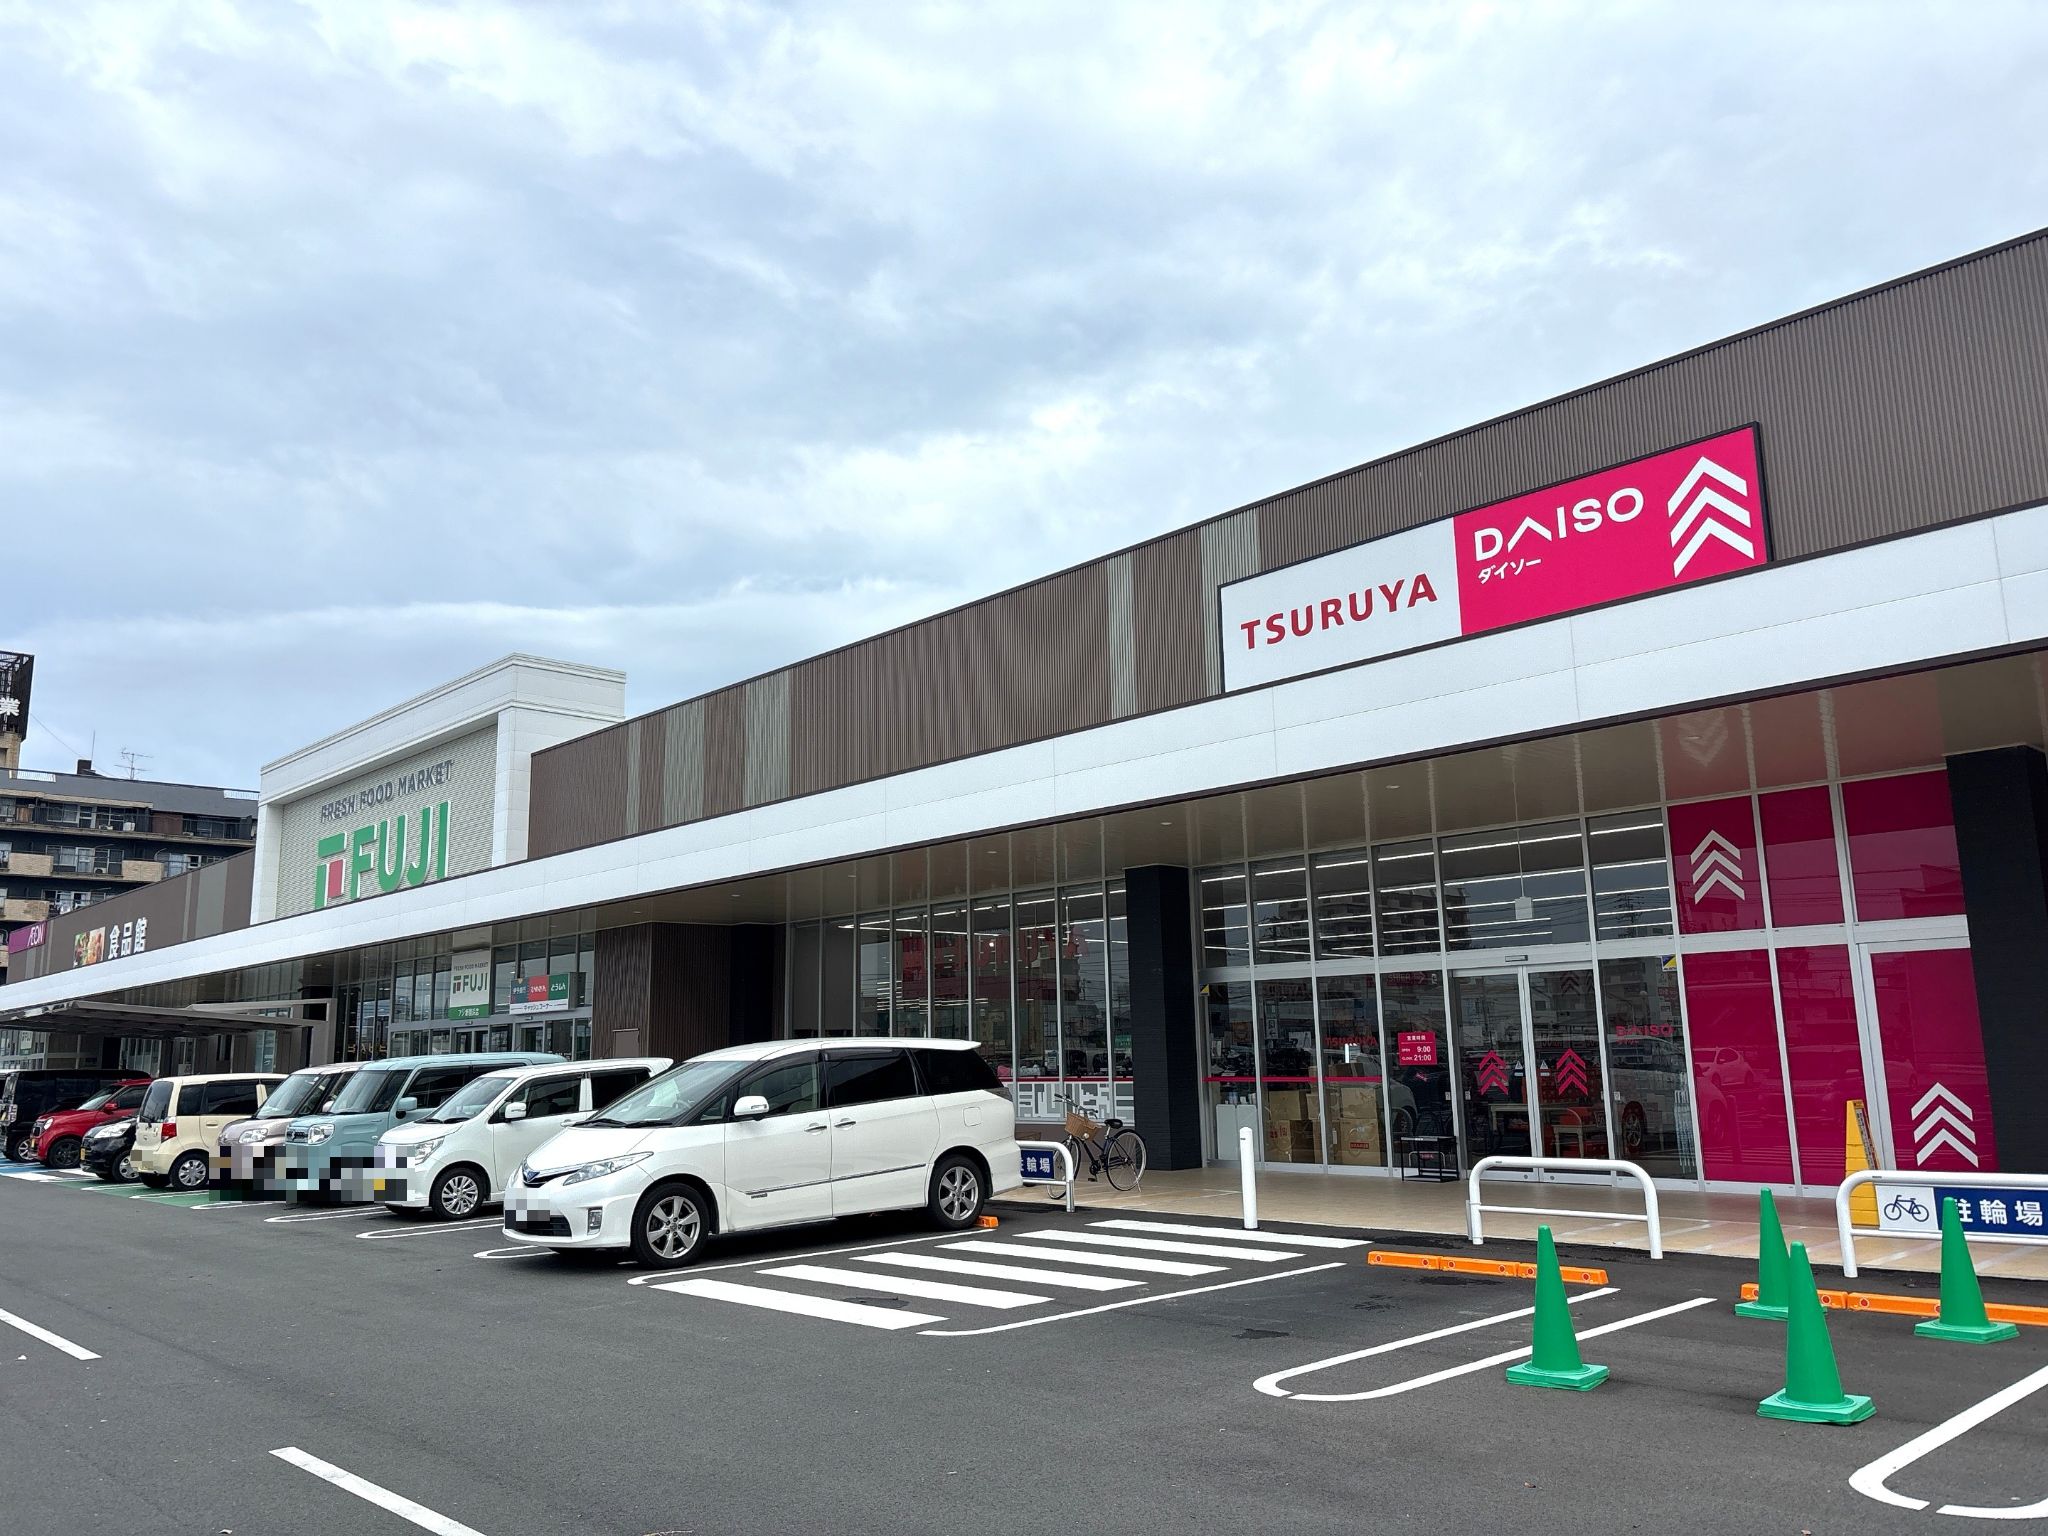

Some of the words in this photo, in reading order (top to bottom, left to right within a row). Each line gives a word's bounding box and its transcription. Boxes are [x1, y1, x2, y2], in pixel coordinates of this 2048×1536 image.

[1475, 487, 1644, 561] DAISO
[1478, 557, 1541, 584] ダイソー
[1240, 573, 1438, 650] TSURUYA
[320, 794, 356, 823] FRESH
[359, 782, 394, 809] FOOD
[398, 760, 454, 796] MARKET
[350, 800, 451, 900] FUJI
[108, 917, 148, 960] 食品館
[463, 973, 488, 992] FUJI
[1020, 1157, 1051, 1173] 輪場
